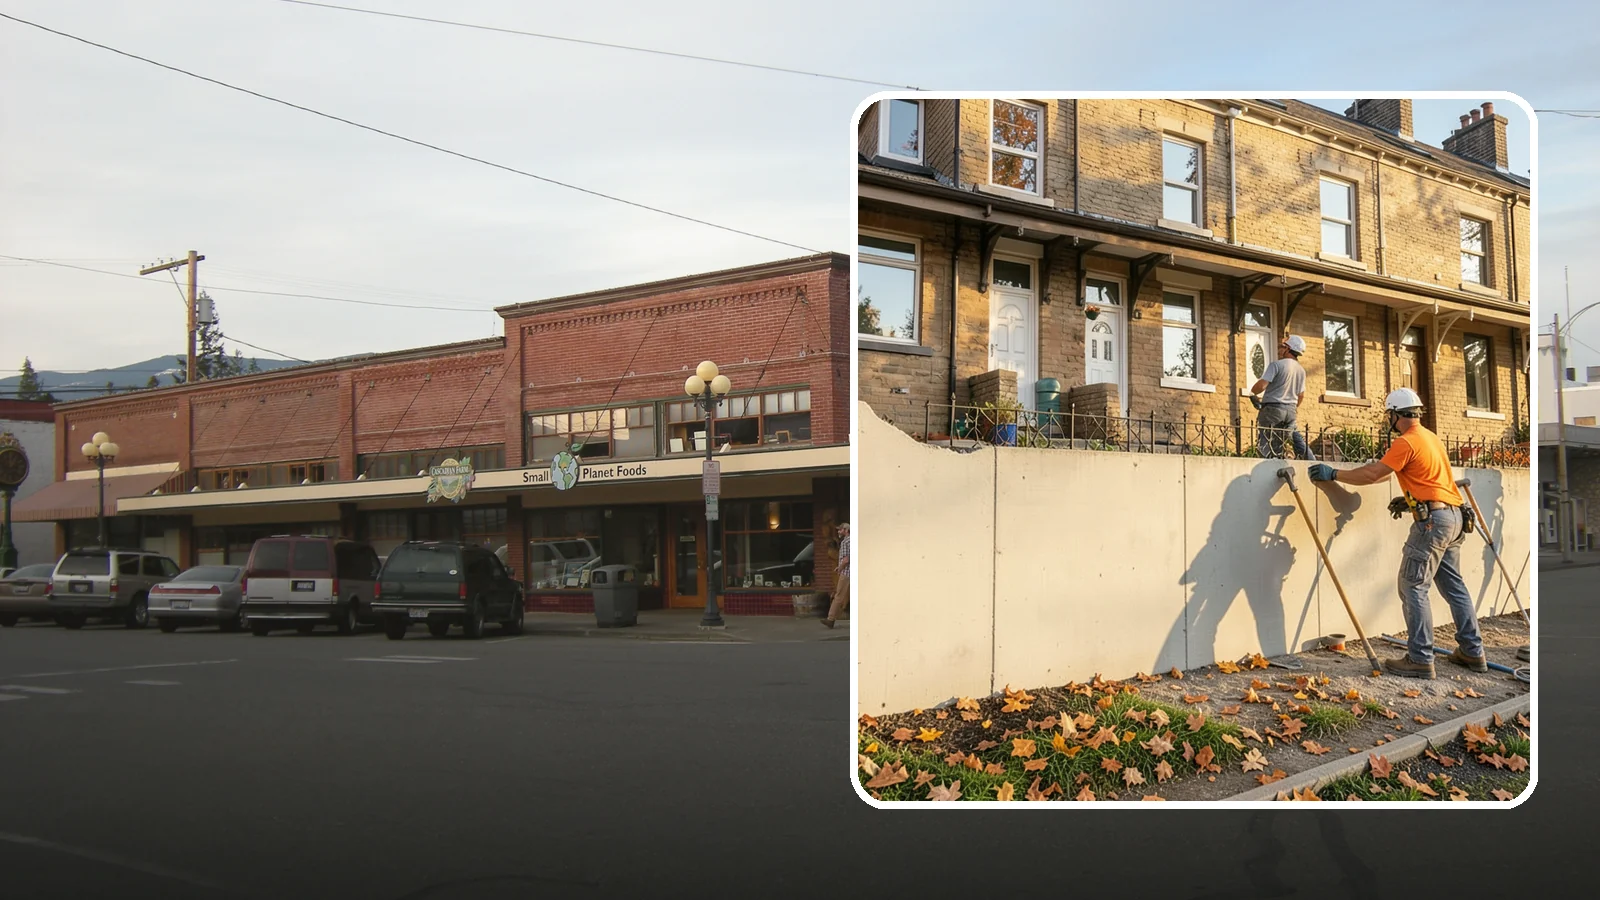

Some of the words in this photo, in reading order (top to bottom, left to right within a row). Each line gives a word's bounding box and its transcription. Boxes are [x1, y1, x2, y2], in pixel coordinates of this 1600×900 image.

[523, 471, 549, 483] Small
[582, 467, 614, 479] Planet
[617, 464, 647, 477] Foods
